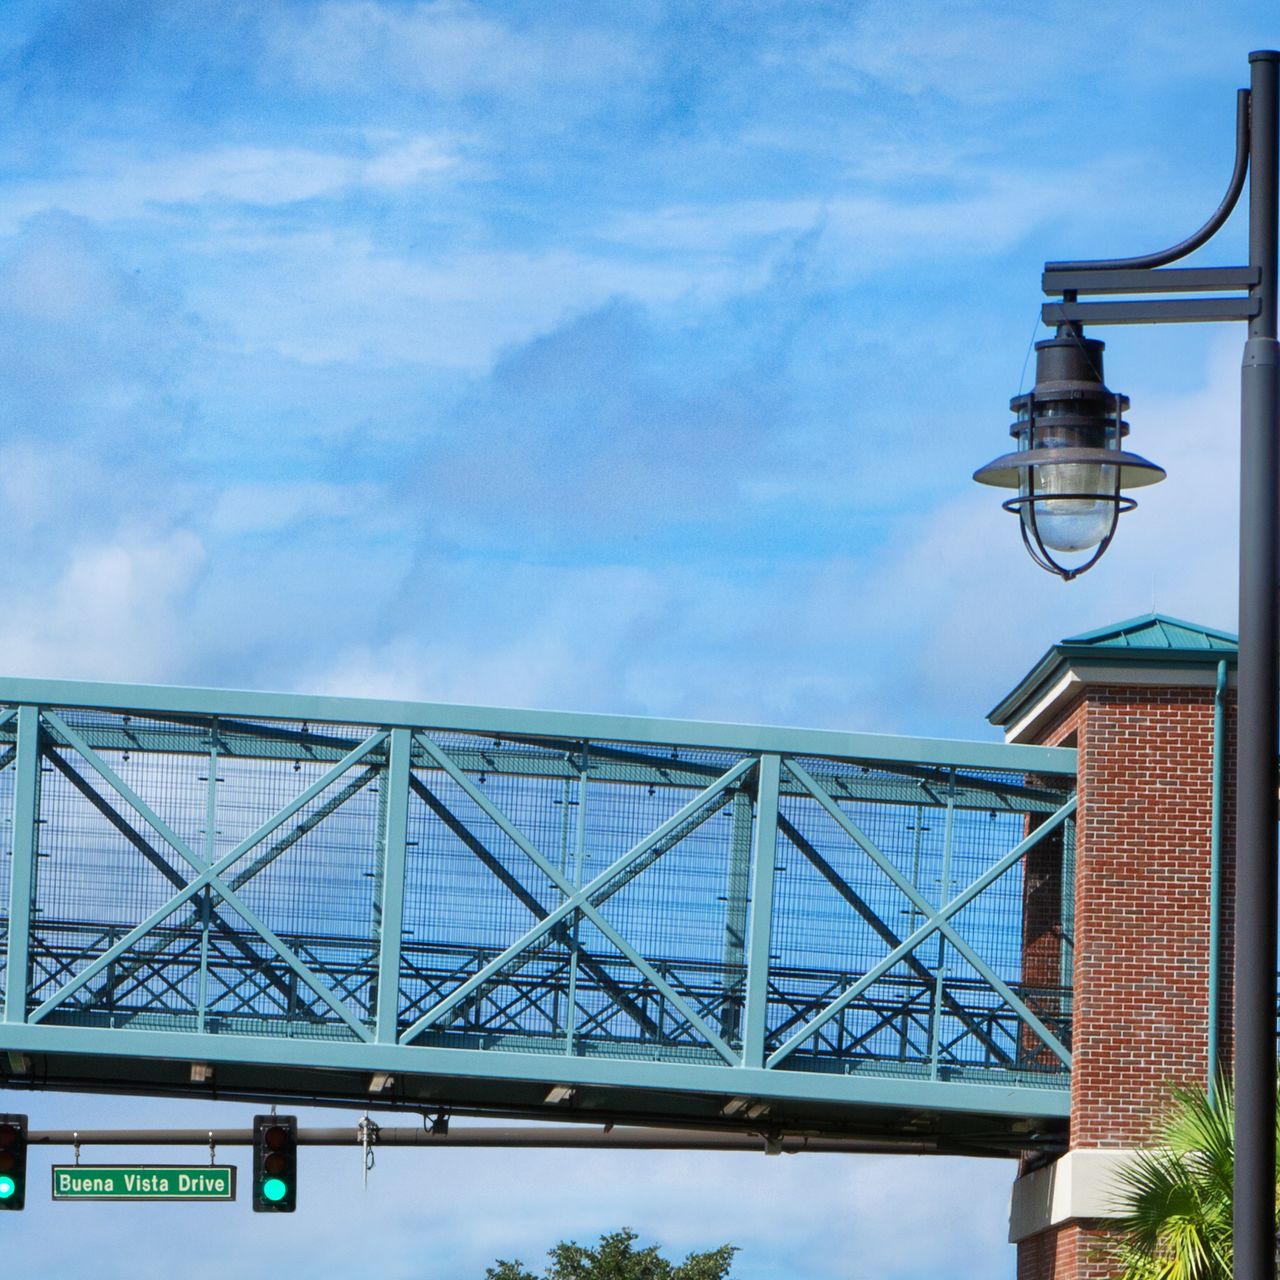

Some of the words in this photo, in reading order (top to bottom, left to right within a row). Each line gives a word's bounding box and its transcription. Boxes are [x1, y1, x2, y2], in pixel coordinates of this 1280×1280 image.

[59, 1174, 113, 1192] Buena
[124, 1174, 169, 1192] Vista
[179, 1174, 225, 1192] Drive
